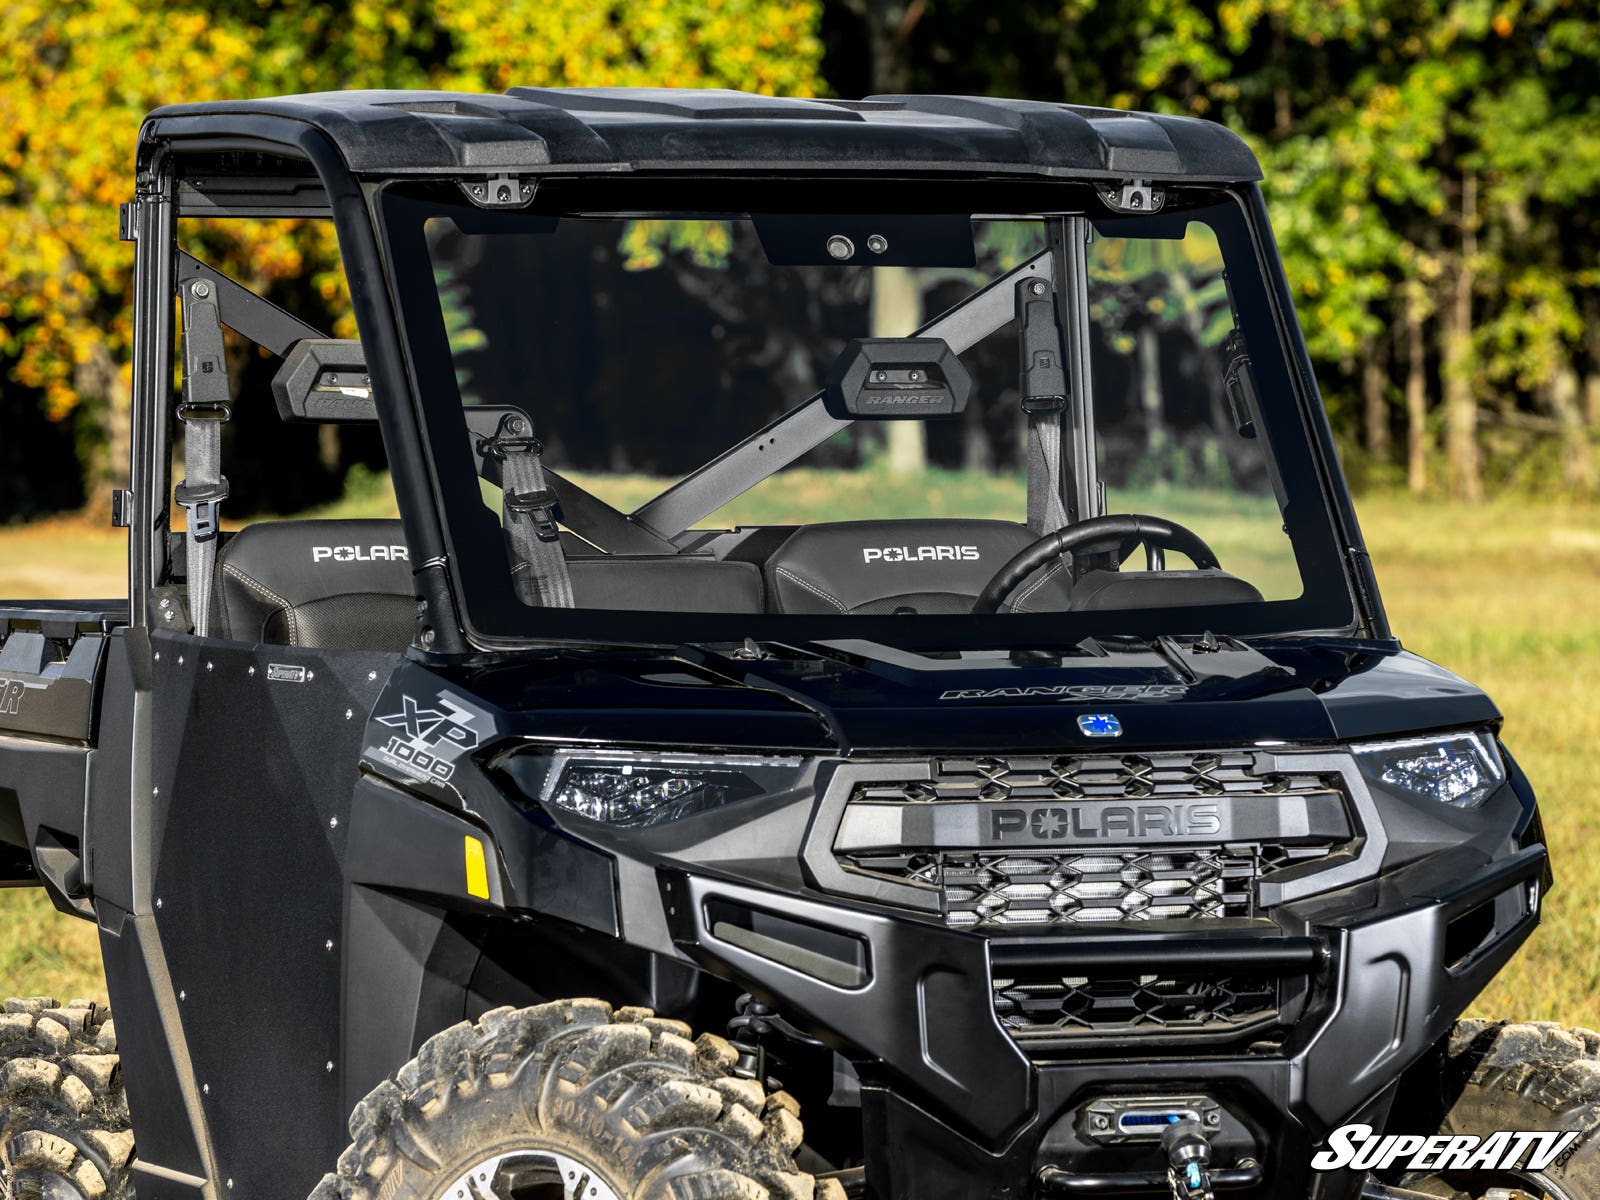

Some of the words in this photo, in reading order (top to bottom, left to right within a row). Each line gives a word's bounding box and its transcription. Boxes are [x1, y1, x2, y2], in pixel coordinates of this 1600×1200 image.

[866, 395, 945, 405] RANGER
[863, 545, 980, 563] POLARIS
[939, 684, 1190, 700] RANGER
[374, 694, 479, 751] XP
[384, 736, 456, 782] 1000
[429, 777, 446, 789] CAM
[991, 803, 1222, 841] POLARIS
